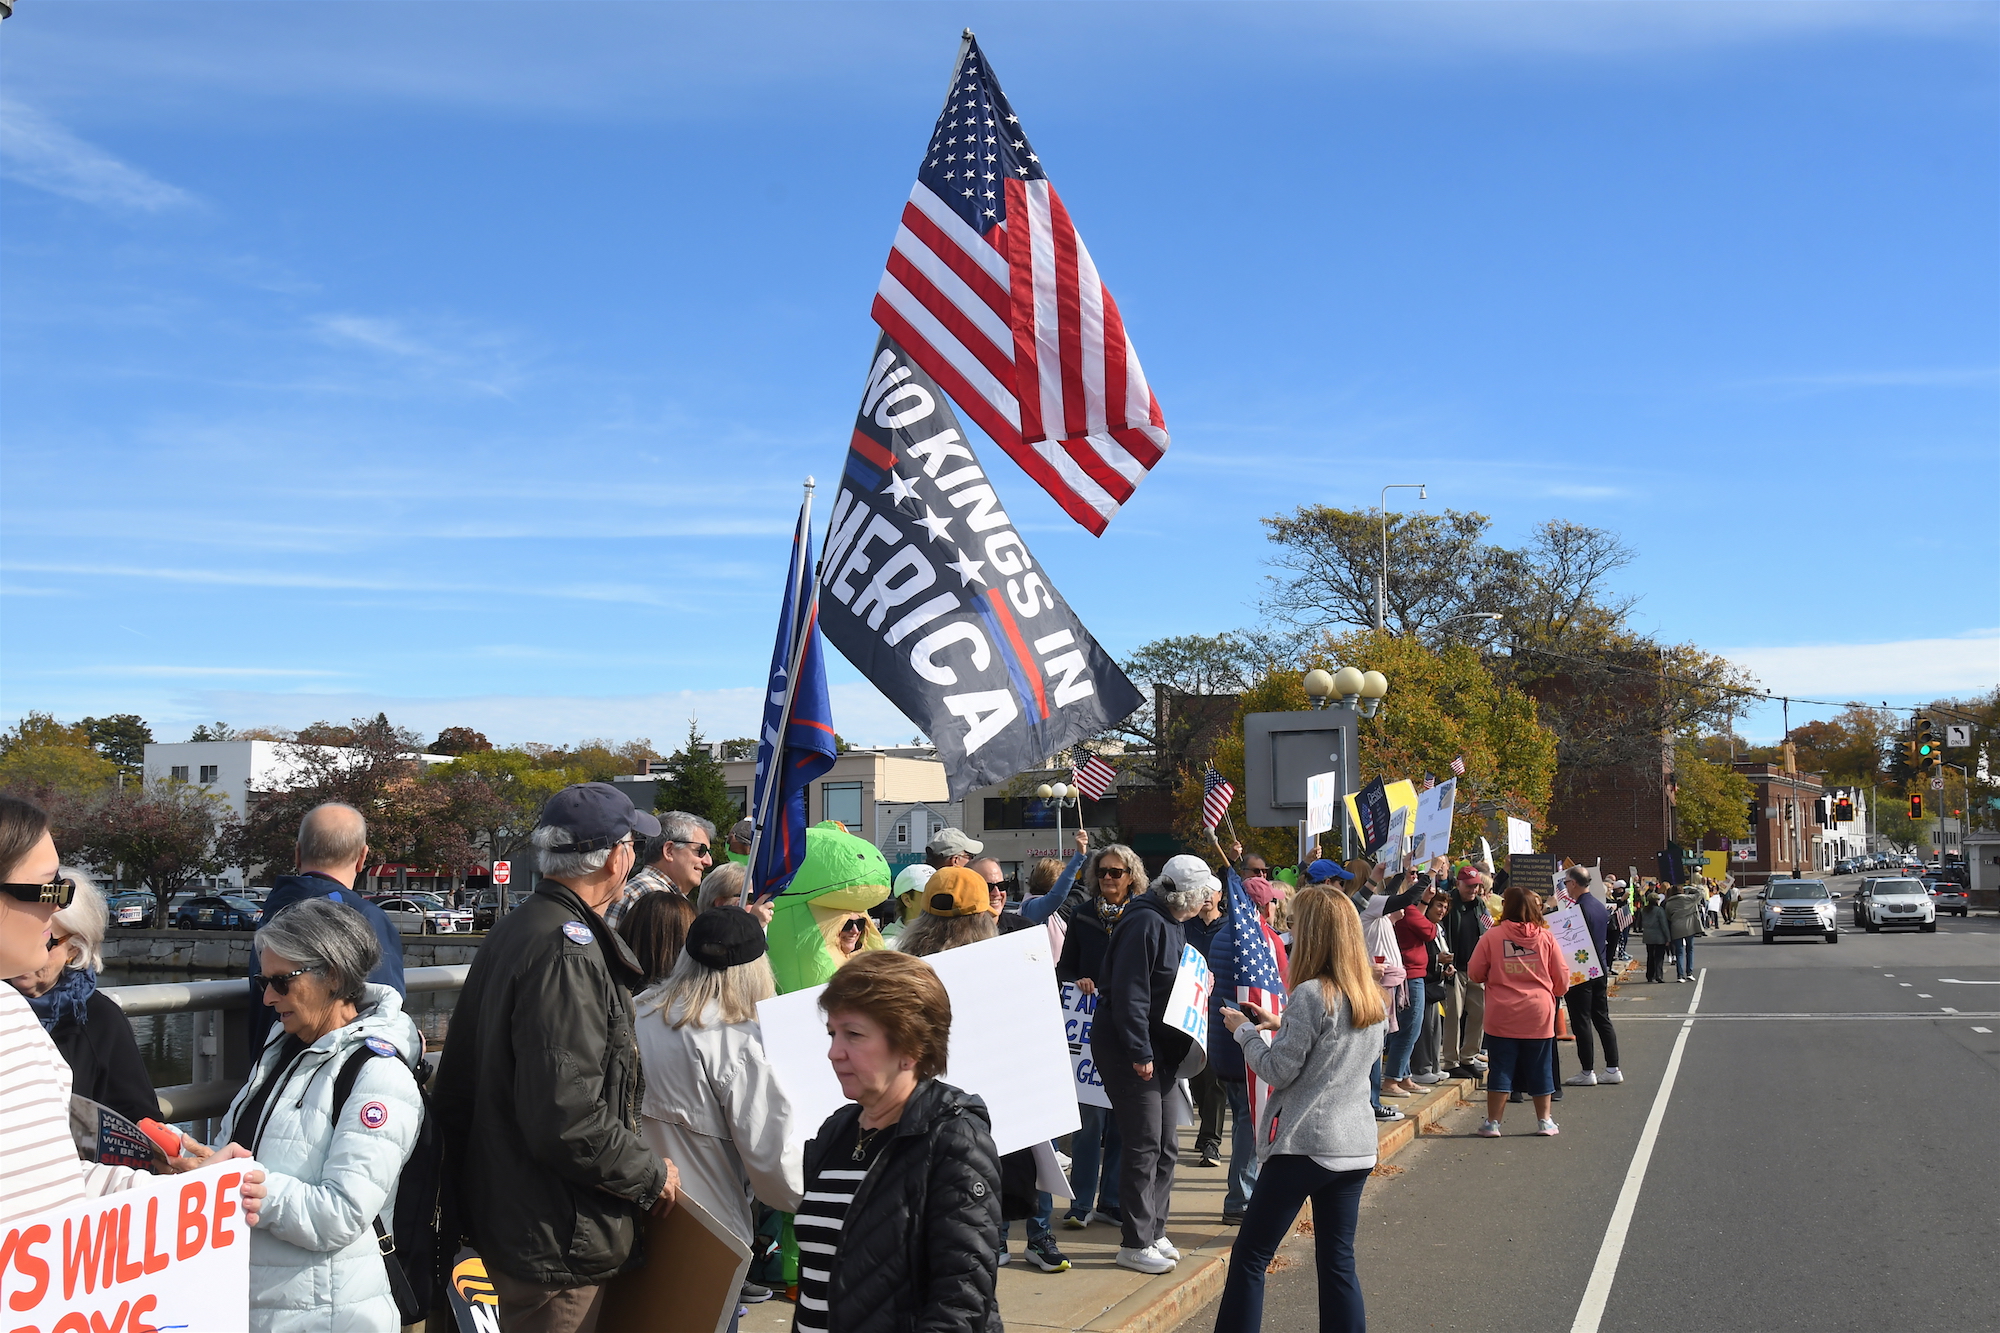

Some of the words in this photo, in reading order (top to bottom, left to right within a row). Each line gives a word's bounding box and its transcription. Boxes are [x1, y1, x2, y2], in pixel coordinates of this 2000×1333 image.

[862, 347, 935, 430] NO
[906, 428, 1054, 618] KINGS
[1033, 628, 1095, 708] IN
[821, 487, 1019, 757] MERICA
[1313, 778, 1324, 800] NO
[1310, 803, 1331, 831] KINGS
[1504, 962, 1536, 974] BD71
[103, 1113, 123, 1127] WE
[103, 1120, 150, 1147] PEOPLE
[103, 1136, 129, 1148] WILL
[131, 1143, 151, 1154] NOT
[120, 1147, 135, 1157] BE
[101, 1153, 152, 1169] SILENT
[63, 1196, 169, 1301] WILL
[176, 1172, 242, 1262] BE
